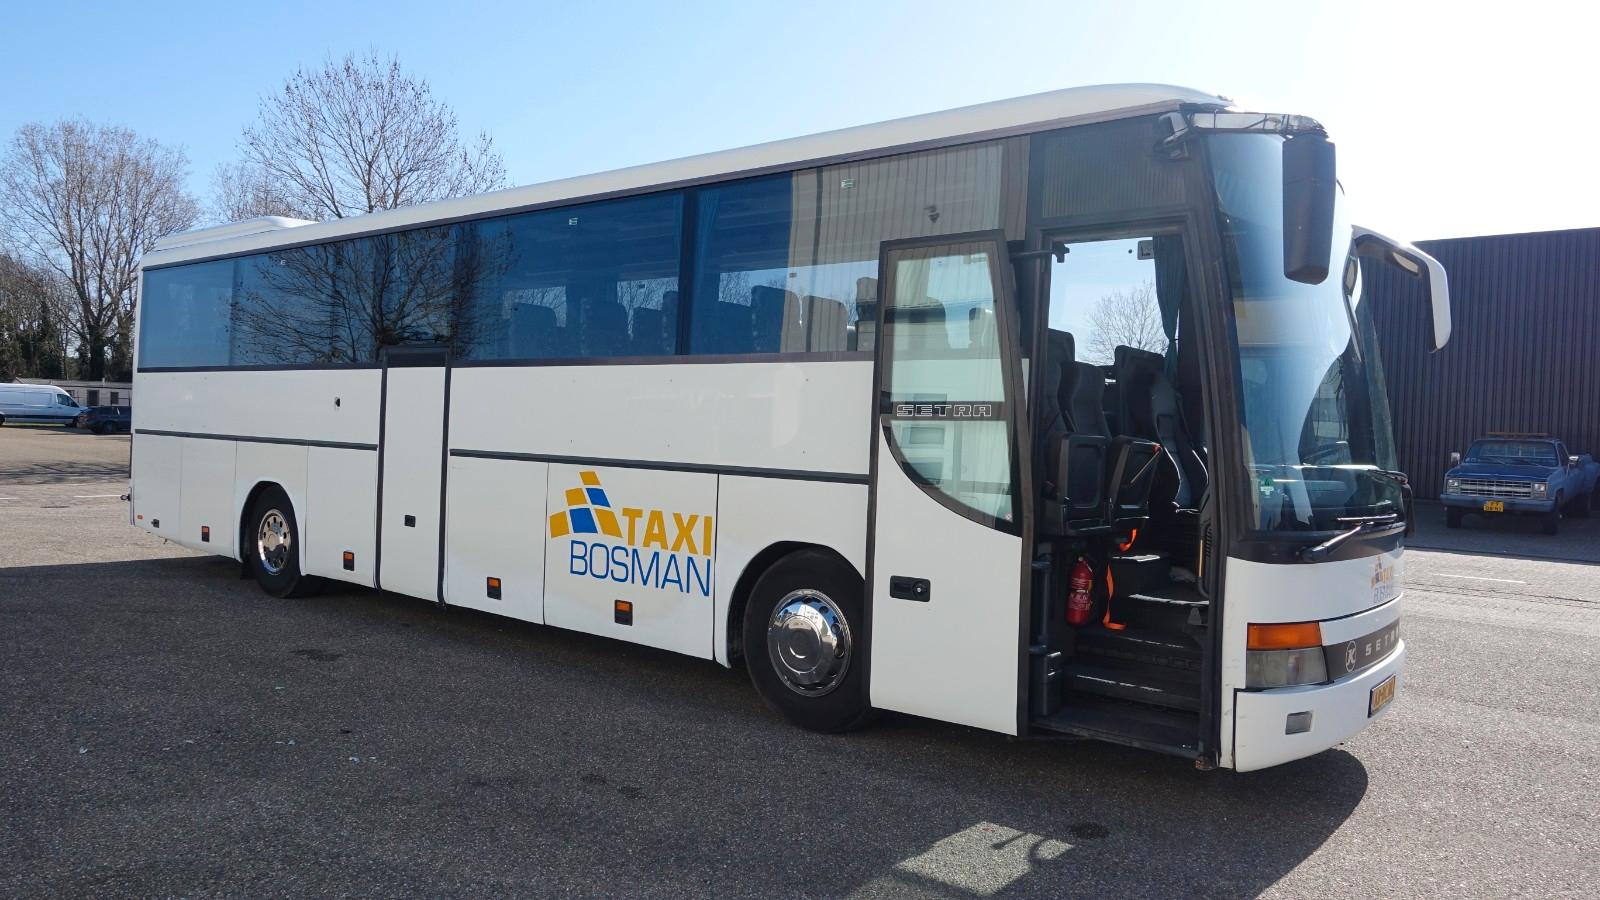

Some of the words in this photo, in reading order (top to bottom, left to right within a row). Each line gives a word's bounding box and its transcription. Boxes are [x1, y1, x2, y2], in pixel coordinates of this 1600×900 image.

[896, 404, 992, 417] SETRA
[622, 507, 713, 556] TAXI
[569, 539, 711, 597] BOSMAN
